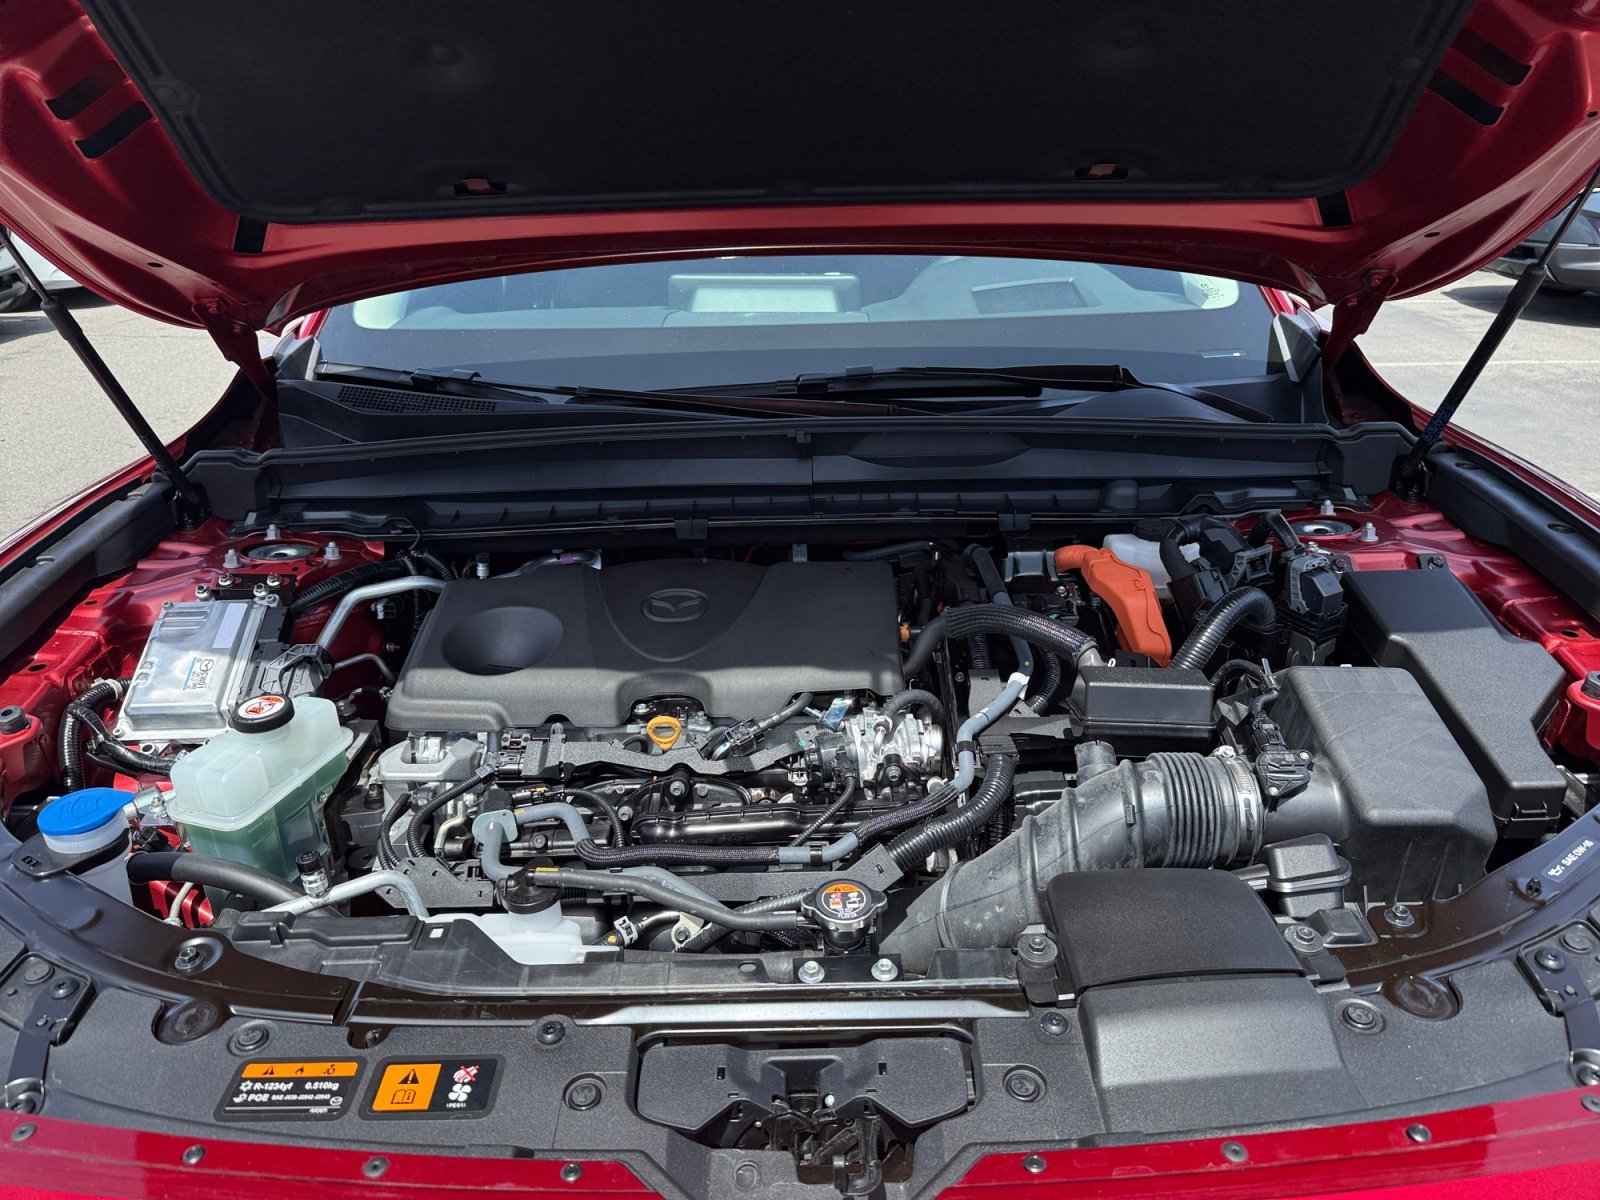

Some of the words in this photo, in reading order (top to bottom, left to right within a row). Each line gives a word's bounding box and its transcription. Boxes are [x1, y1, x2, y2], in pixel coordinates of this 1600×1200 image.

[1561, 853, 1578, 866] SAE
[252, 1081, 293, 1092] R-1234yf
[304, 1081, 340, 1091] 0.510kg
[247, 1093, 270, 1102] POE
